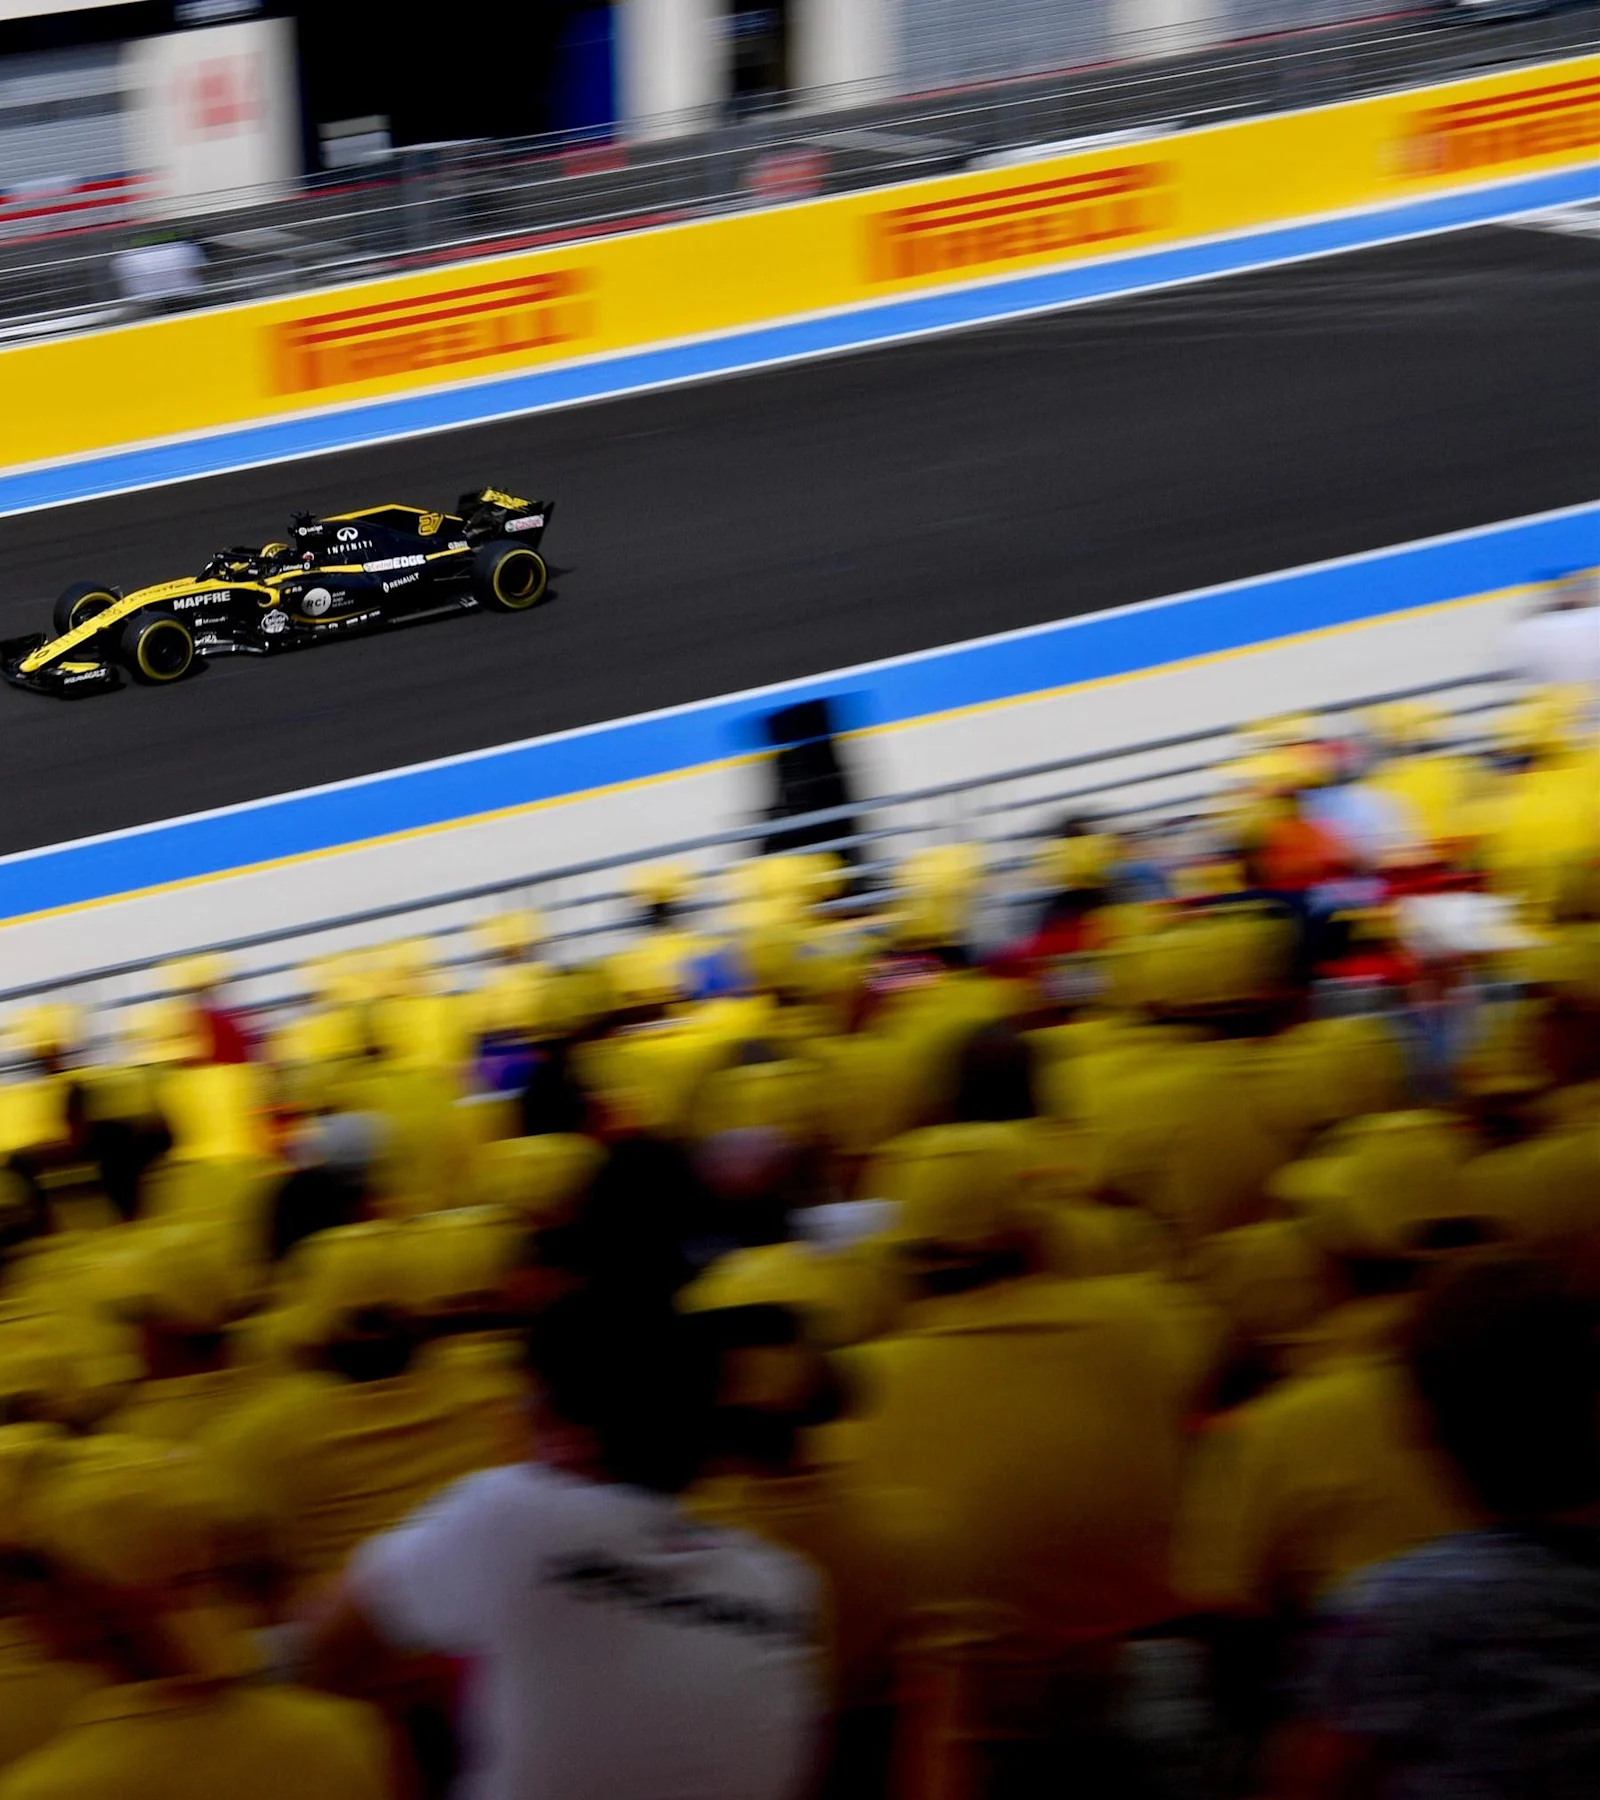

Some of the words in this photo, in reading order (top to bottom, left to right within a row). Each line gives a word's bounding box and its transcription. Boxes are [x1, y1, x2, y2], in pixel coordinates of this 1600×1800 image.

[862, 160, 1180, 285] PIRELLI
[262, 267, 597, 396] PIRELLI
[418, 512, 444, 536] 27
[327, 540, 373, 555] INFINITI
[393, 554, 426, 569] EDGE
[389, 572, 420, 589] RENAULT
[173, 590, 231, 611] MAPFRE
